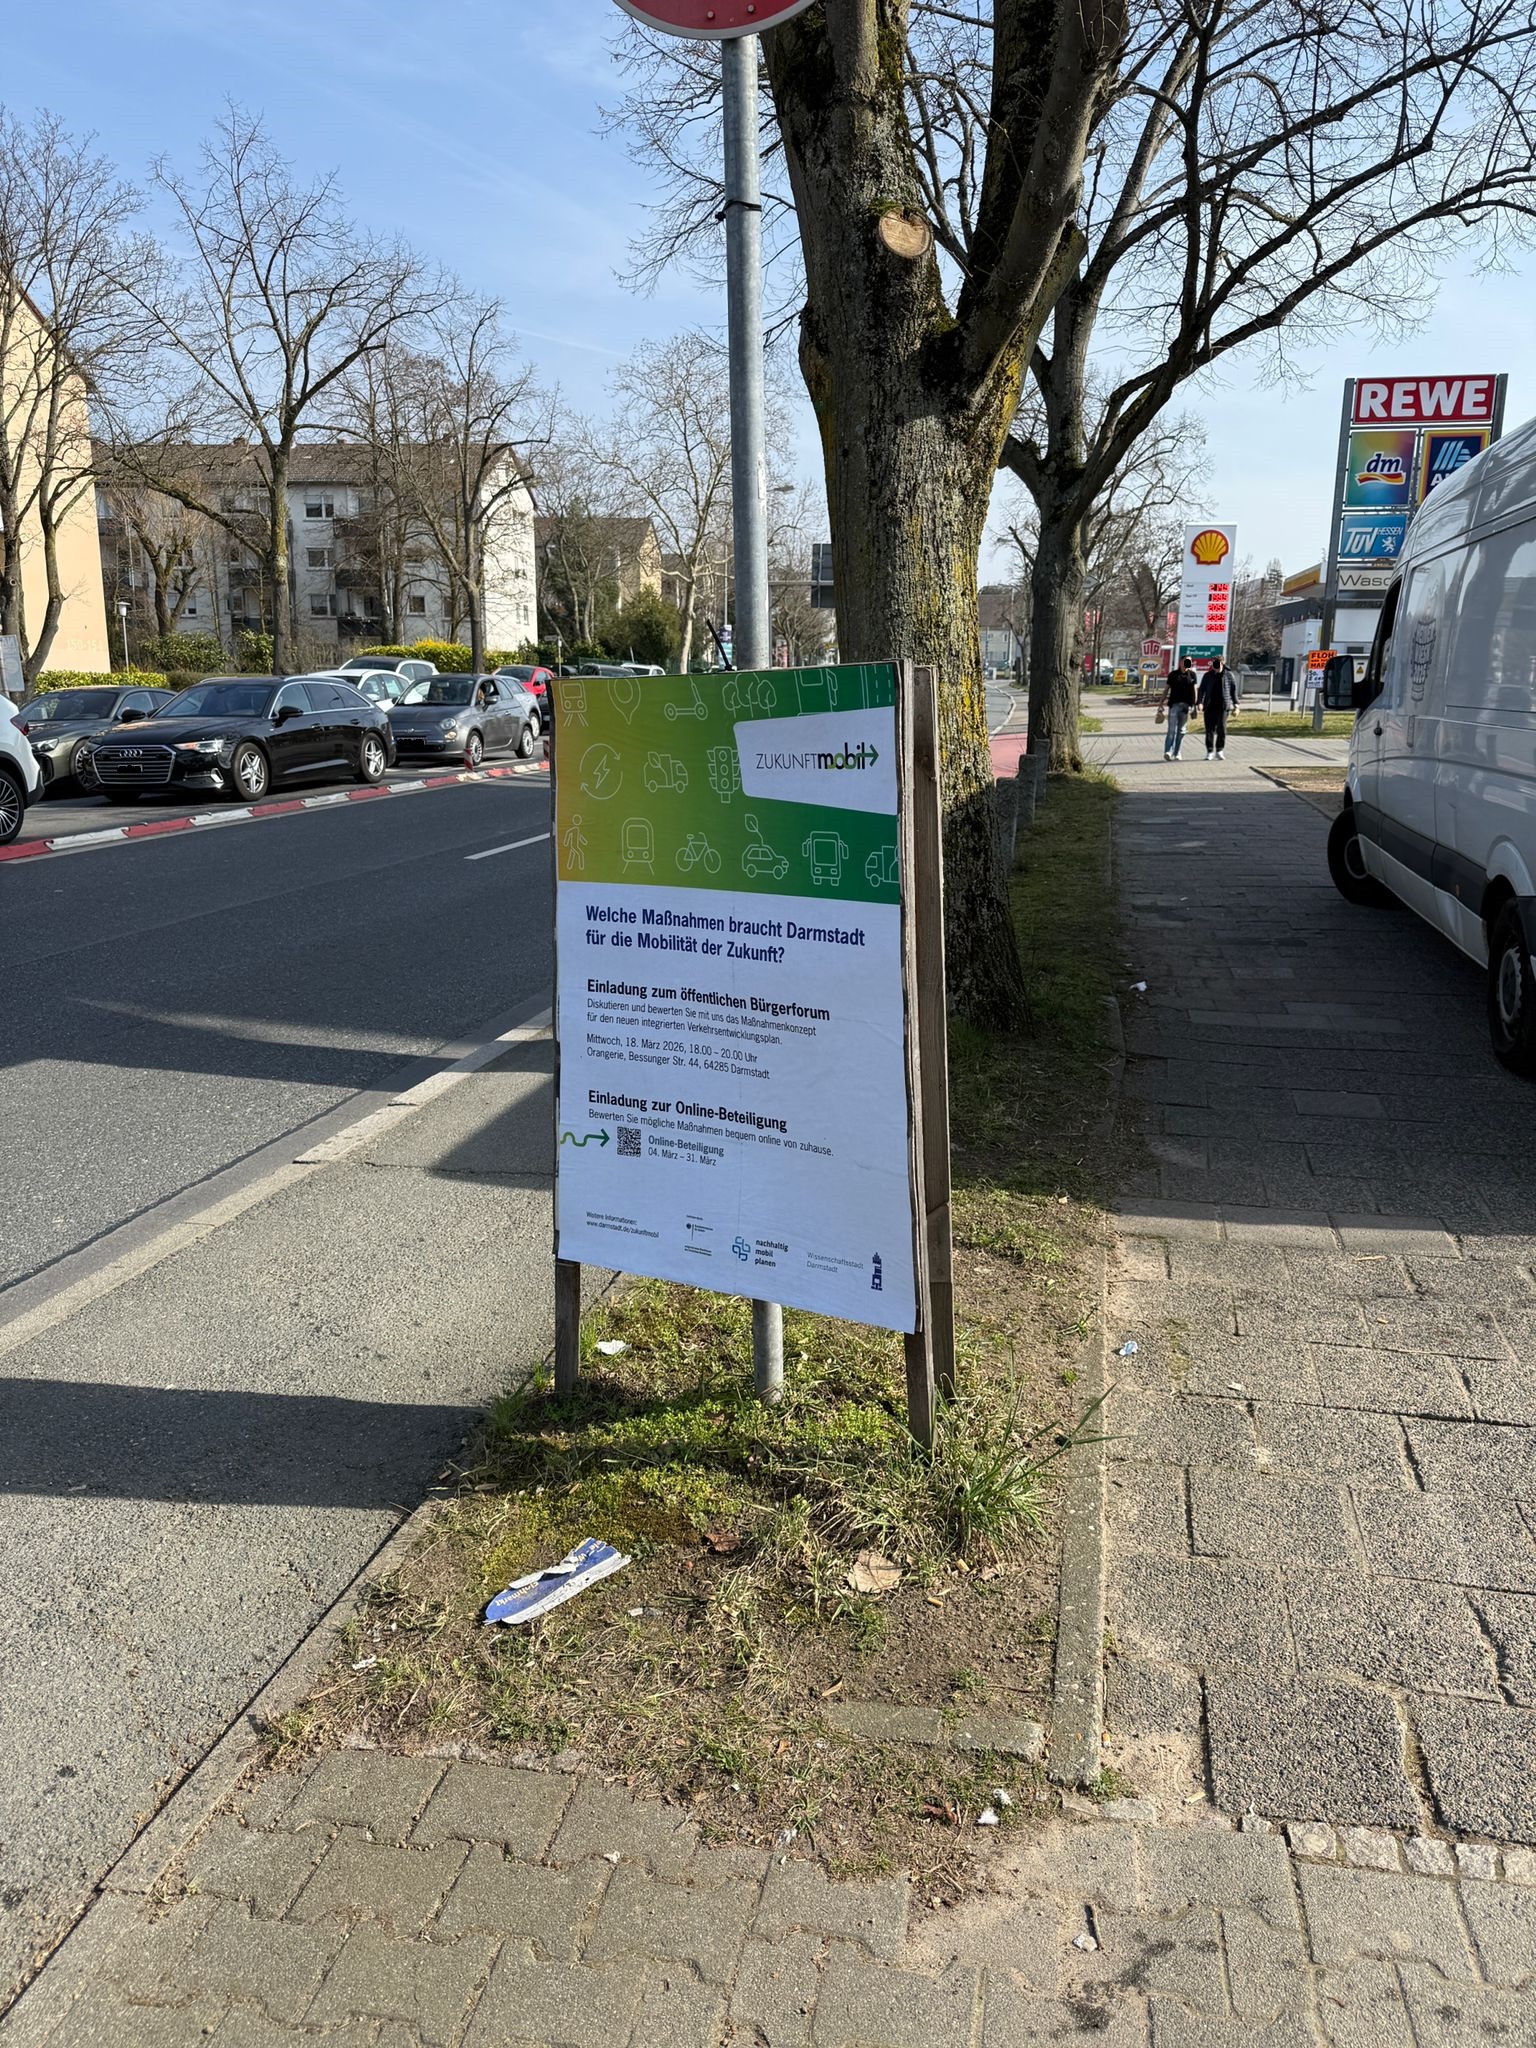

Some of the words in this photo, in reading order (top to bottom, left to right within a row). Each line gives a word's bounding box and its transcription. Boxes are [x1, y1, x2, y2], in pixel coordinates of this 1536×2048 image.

[1359, 379, 1489, 418] REWE
[1366, 452, 1402, 474] dm
[1378, 526, 1404, 535] HESSEN
[585, 904, 636, 923] Welche
[642, 908, 724, 931] Maßnahmen
[728, 915, 782, 937] braucht
[786, 921, 865, 946] Darmstadt
[585, 928, 606, 945] für
[610, 930, 632, 947] die
[637, 932, 697, 952] Mobilität
[701, 938, 722, 955] der
[726, 940, 784, 963] Zukunft?
[587, 978, 647, 999] Einladung
[651, 987, 676, 999] zum
[680, 987, 746, 1009] öffentlichen
[749, 996, 830, 1020] Bürgerforum
[586, 1011, 597, 1021] für
[599, 1013, 613, 1023] den
[615, 1016, 639, 1025] neuen
[641, 1018, 685, 1030] integrierten
[687, 1022, 782, 1044] Verkehrsentwicklungsplan.
[587, 997, 629, 1011] Diskutieren
[631, 1002, 645, 1012] und
[647, 1003, 683, 1016] bewerten
[685, 1007, 696, 1018] Sie
[698, 1011, 709, 1020] mit
[711, 1013, 724, 1022] uns
[725, 1013, 739, 1024] das
[740, 1015, 816, 1037] Maßnahmenkonzept
[586, 1032, 622, 1047] Mittwoch,
[626, 1036, 638, 1047] 18.
[641, 1038, 660, 1049] März
[662, 1040, 686, 1053] 2026,
[689, 1043, 712, 1056] 18.00
[720, 1047, 743, 1060] 20.00
[744, 1052, 757, 1062] Uhr
[586, 1046, 626, 1061] Orangerie,
[628, 1050, 670, 1065] Bessunger
[672, 1055, 685, 1066] Str.
[688, 1057, 701, 1069] 44,
[703, 1058, 729, 1072] 64285
[730, 1063, 770, 1079] Darmstadt
[588, 1089, 647, 1112] Einladung
[651, 1100, 671, 1112] zur
[675, 1100, 787, 1133] Online-Beteiligung
[588, 1108, 624, 1121] Bewerten
[626, 1113, 638, 1123] Sie
[640, 1116, 675, 1129] mögliche
[676, 1120, 723, 1136] Maßnahmen
[725, 1127, 756, 1141] bequem
[758, 1134, 781, 1145] online
[782, 1139, 797, 1148] von
[799, 1141, 833, 1156] zuhause.
[648, 1134, 724, 1157] Online-Beteiligung
[647, 1146, 659, 1156] 04.
[661, 1148, 677, 1159] März
[686, 1152, 697, 1162] 31.
[699, 1154, 716, 1166] März
[754, 1249, 773, 1257] mobil
[755, 1239, 788, 1252] nachhaltig
[807, 1251, 863, 1269] Wissenschaftsstadt
[754, 1257, 776, 1267] planen
[806, 1260, 837, 1272] Darmstadt
